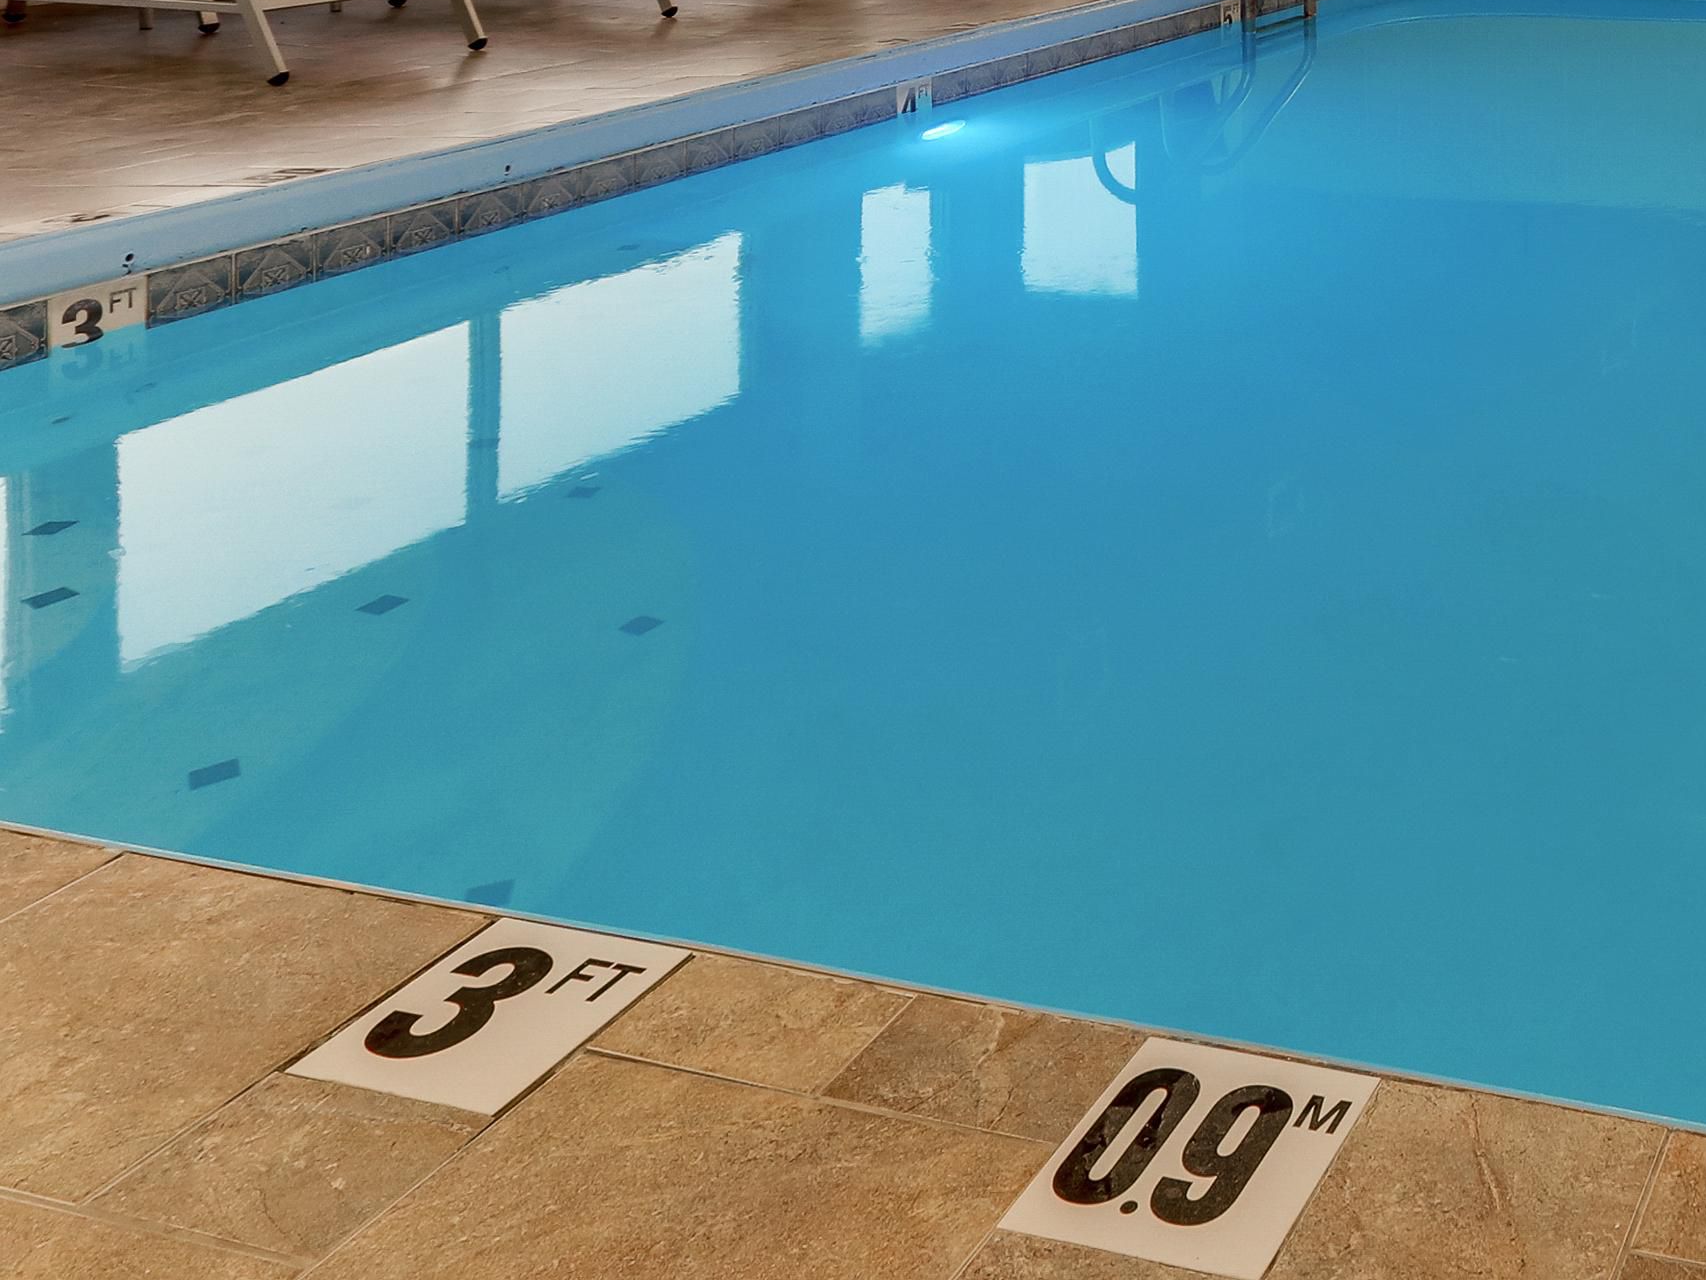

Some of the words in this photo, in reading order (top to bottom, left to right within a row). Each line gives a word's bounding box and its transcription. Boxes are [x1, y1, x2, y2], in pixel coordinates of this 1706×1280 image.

[61, 298, 104, 350] 3
[109, 286, 138, 314] FT
[364, 946, 554, 1059] 3
[545, 957, 647, 1003] FT
[1052, 1067, 1294, 1227] 0.9
[1292, 1094, 1353, 1135] M
